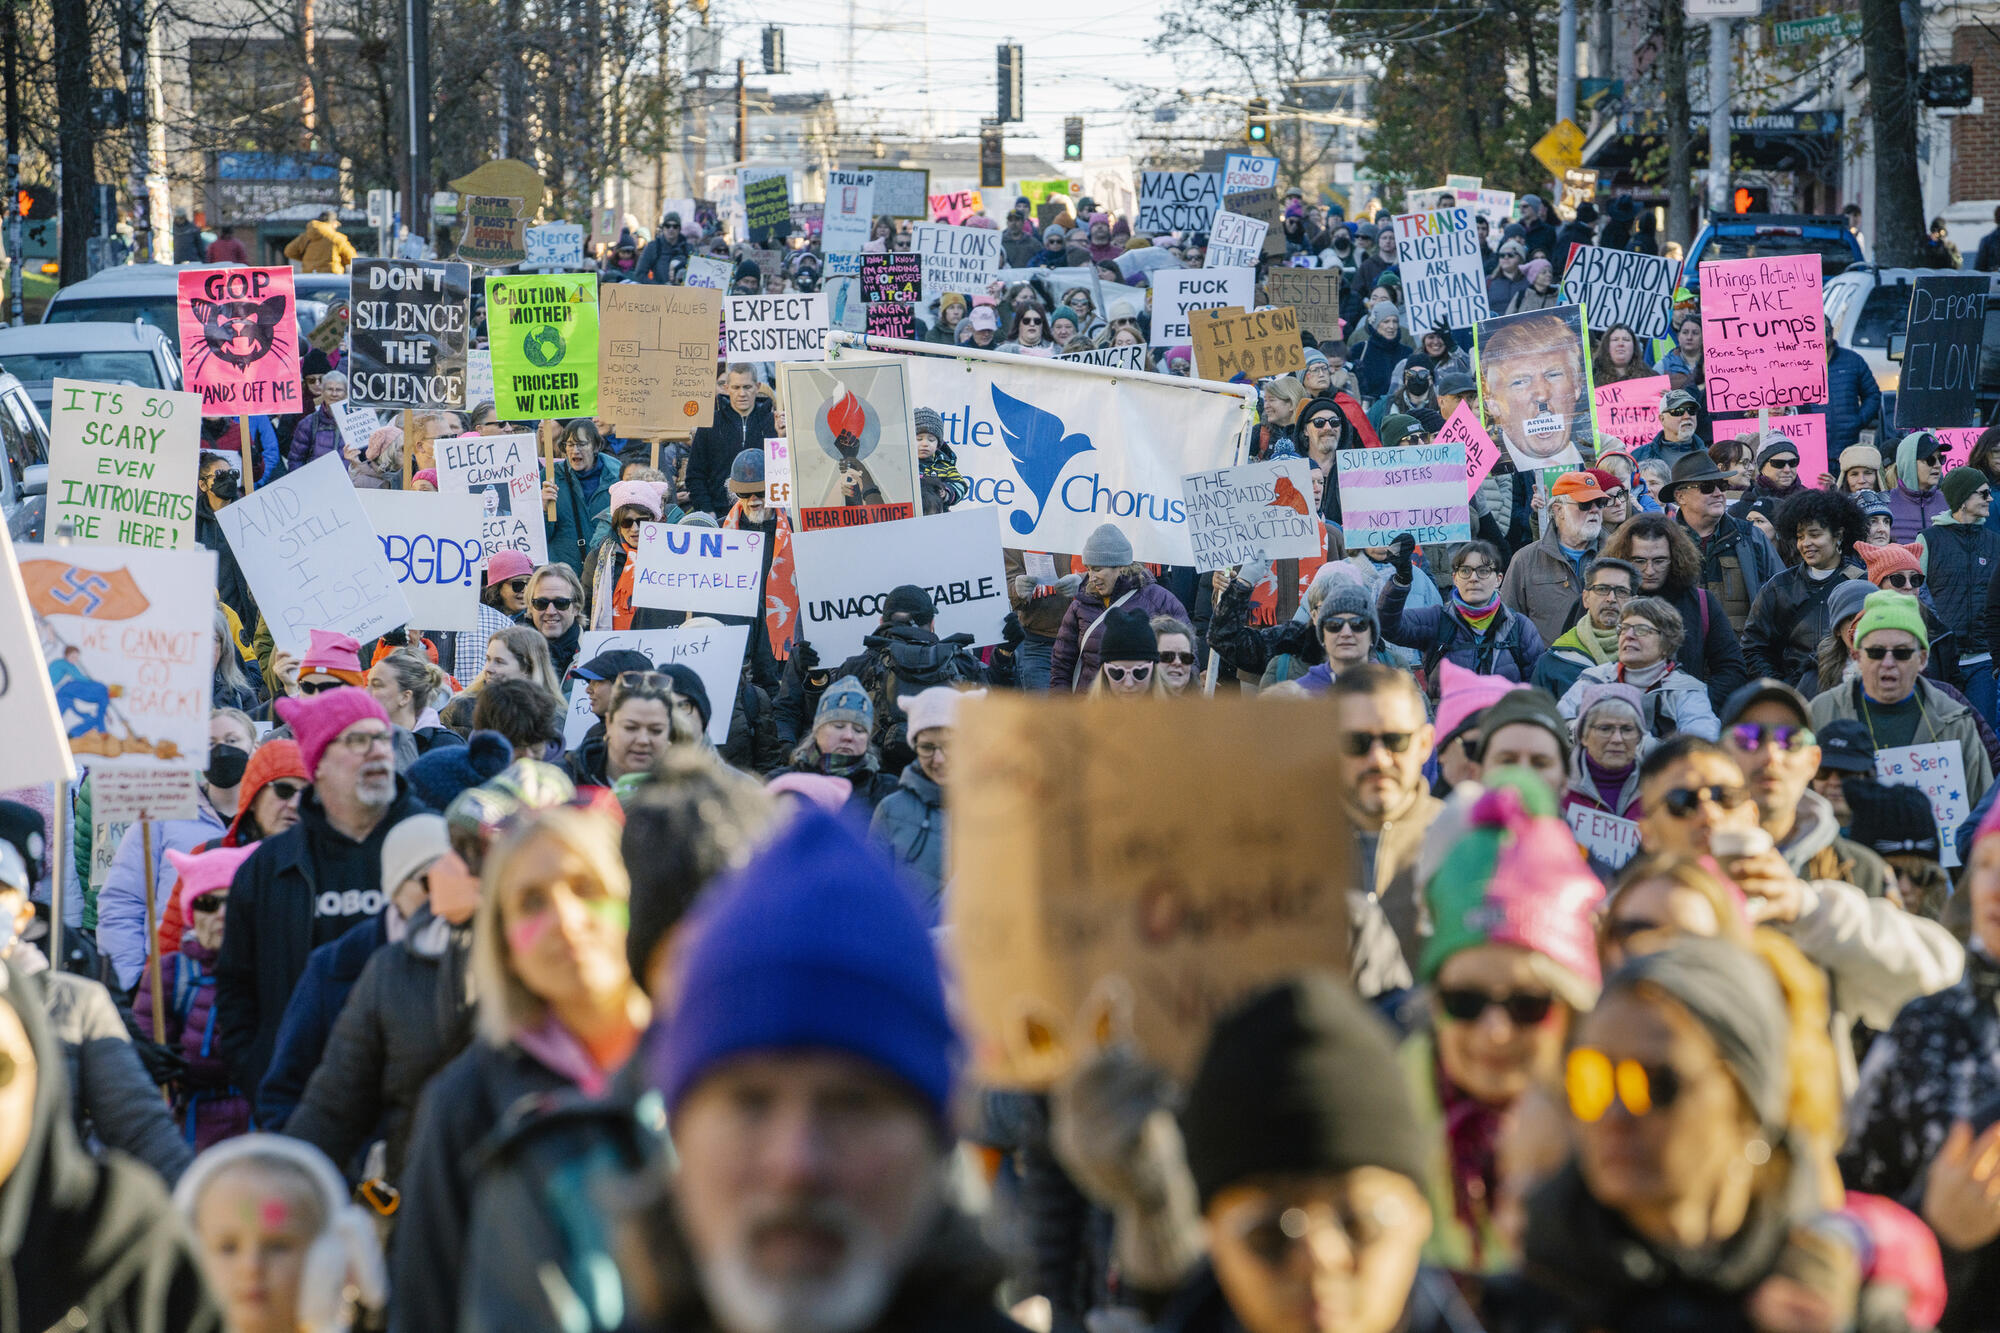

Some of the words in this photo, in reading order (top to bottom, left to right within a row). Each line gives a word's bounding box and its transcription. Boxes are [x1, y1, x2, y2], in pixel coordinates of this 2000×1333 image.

[1780, 23, 1841, 43] Harvard
[1736, 114, 1795, 130] EGYPTIAN
[1238, 158, 1263, 173] NO
[829, 172, 874, 187] TRUMP
[1141, 172, 1219, 203] MAGA
[1226, 171, 1270, 187] FORCED
[474, 195, 510, 208] SUPER
[1215, 215, 1265, 248] EAT
[1396, 208, 1468, 238] TRANS
[1208, 243, 1257, 268] THE
[1399, 228, 1477, 263] RIGHTS
[877, 265, 920, 275] STANDING
[895, 254, 916, 263] KNOW
[958, 256, 986, 271] NOT
[1425, 259, 1455, 277] ARE
[368, 266, 446, 294] DON'T
[863, 275, 874, 284] UP
[894, 274, 922, 283] MYSELF
[1563, 246, 1682, 297] ABORTION
[1698, 265, 1757, 292] Things
[492, 283, 567, 306] CAUTION
[869, 290, 918, 302] BITCH!
[879, 284, 899, 292] SUCH
[904, 282, 914, 293] A
[1179, 280, 1229, 295] FUCK
[1406, 269, 1482, 305] HUMAN
[356, 300, 464, 333] SILENCE
[509, 306, 573, 325] MOTHER
[732, 298, 814, 322] EXPECT
[868, 303, 911, 316] ANGRY
[1409, 294, 1488, 333] RIGHTS
[1912, 288, 1991, 324] DEPORT
[868, 315, 912, 327] WOMEN
[1210, 319, 1236, 347] IT
[1240, 312, 1269, 341] IS
[1271, 309, 1296, 332] ON
[1708, 314, 1817, 345] Trump's
[615, 344, 634, 353] YES
[685, 346, 703, 358] NO
[727, 328, 828, 352] RESISTENCE
[382, 340, 431, 365] THE
[1261, 343, 1300, 372] FOS
[1736, 346, 1765, 360] Spurs
[607, 364, 641, 374] HONOR
[675, 366, 715, 377] BIGOTRY
[1906, 342, 1980, 391] ELON
[193, 383, 236, 405] HANDS
[242, 380, 268, 401] OFF
[272, 379, 298, 401] ME
[352, 371, 462, 404] SCIENCE
[512, 372, 579, 392] PROCEED
[602, 387, 629, 397] BASIC
[603, 376, 660, 386] INTEGRITY
[672, 378, 705, 388] RACISM
[1708, 364, 1828, 411] Presidency!
[62, 388, 124, 415] IT'S
[142, 397, 174, 419] SO
[516, 394, 535, 414] W/
[539, 392, 580, 412] CARE
[672, 390, 713, 398] IGNORANCE
[607, 405, 646, 417] TRUTH
[81, 420, 166, 455] SCARY
[1452, 416, 1483, 468] EQUAL
[446, 443, 496, 470] ELECT
[504, 442, 522, 464] A
[1341, 448, 1406, 472] SUPPORT
[1414, 445, 1450, 464] YOUR
[96, 457, 156, 480] EVEN
[467, 464, 514, 485] CLOWN
[1384, 466, 1434, 486] SISTERS
[510, 468, 540, 498] FELON
[1186, 470, 1233, 492] THE
[57, 479, 194, 522] INTROVERTS
[1060, 472, 1187, 524] Chorus
[1184, 482, 1275, 514] HANDMAID'S
[236, 485, 302, 550] AND
[512, 520, 528, 536] A
[806, 509, 840, 528] HEAR
[842, 507, 870, 526] OUR
[870, 506, 909, 524] VOICE
[1189, 506, 1240, 531] TALE
[1262, 508, 1278, 519] not
[1284, 508, 1299, 518] an
[1368, 510, 1401, 528] NOT
[1408, 506, 1453, 526] JUST
[118, 520, 179, 550] HERE!
[279, 508, 353, 560] STILL
[1191, 517, 1315, 554] INSTRUCTION
[1196, 544, 1260, 572] MANUAL
[287, 557, 320, 590] I
[639, 567, 759, 591] ACCEPTABLE!
[280, 560, 391, 643] RISE!
[80, 622, 111, 651] WE
[120, 627, 203, 659] CANNOT
[670, 635, 713, 663] just
[138, 658, 171, 687] GO
[1909, 752, 1950, 772] Seen
